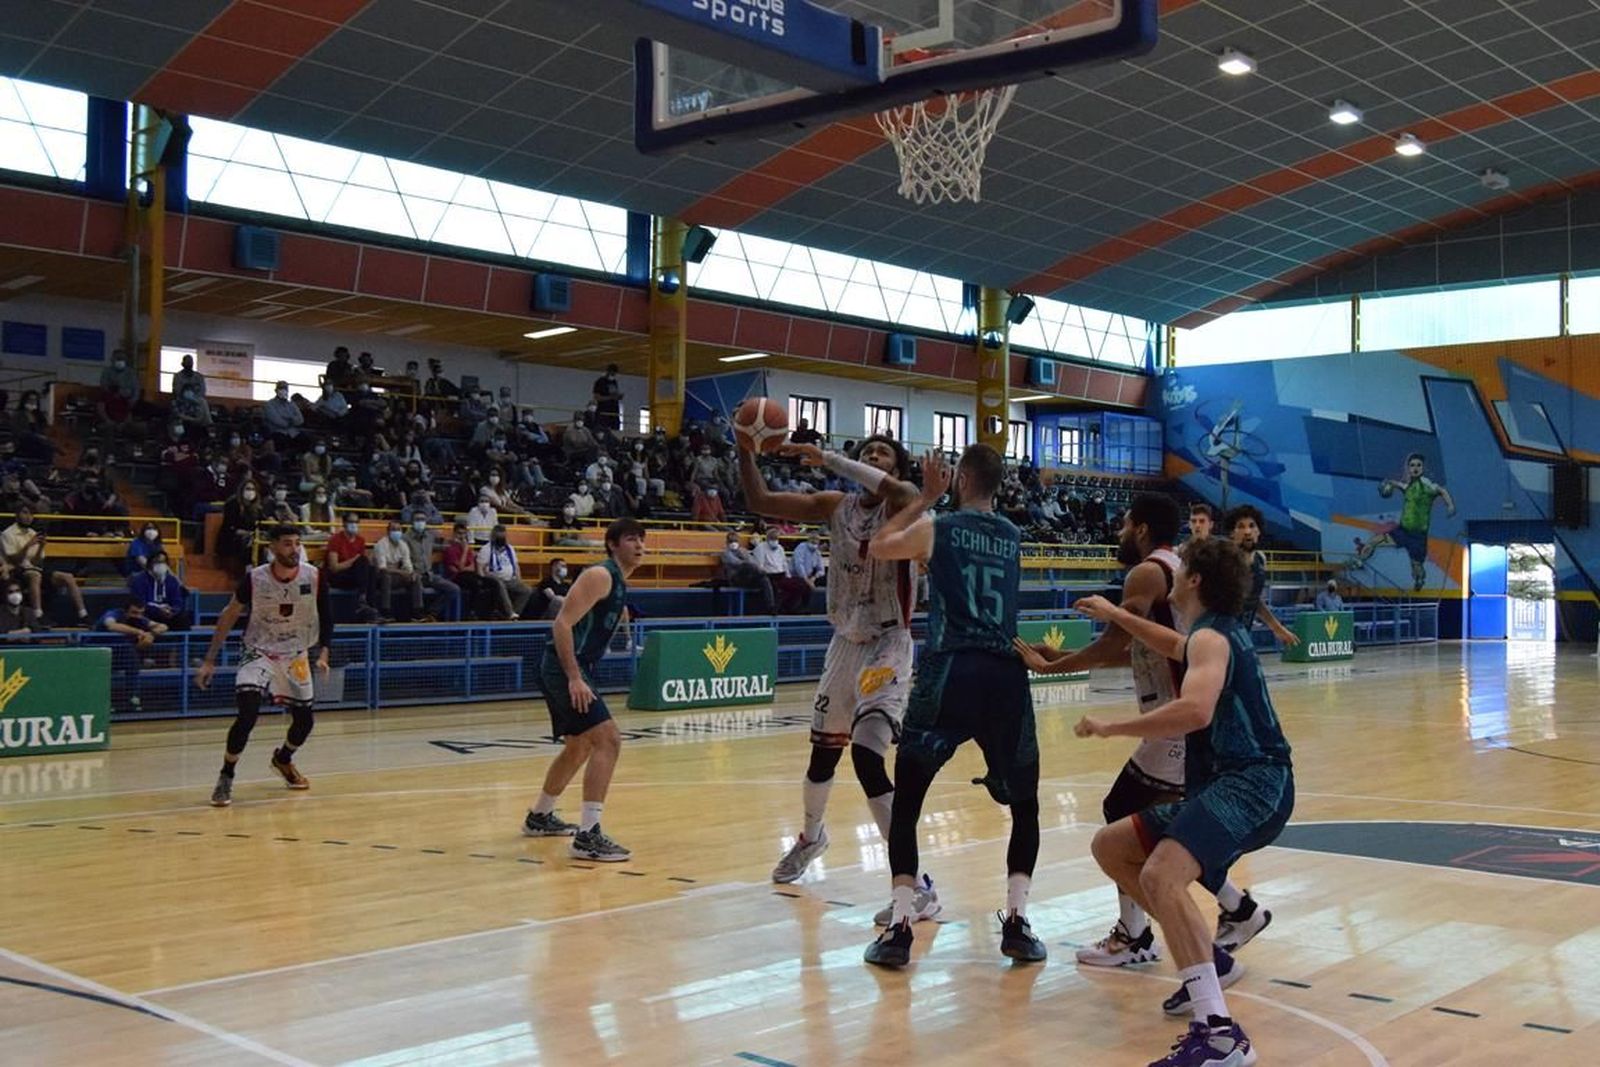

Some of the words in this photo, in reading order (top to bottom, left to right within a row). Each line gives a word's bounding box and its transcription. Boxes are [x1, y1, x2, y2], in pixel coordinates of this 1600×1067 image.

[951, 527, 1018, 561] SCHILDER
[961, 563, 1005, 624] 15
[661, 679, 709, 703] CAJA
[710, 674, 773, 699] RURAL
[814, 694, 830, 714] 22
[0, 714, 105, 749] URAL
